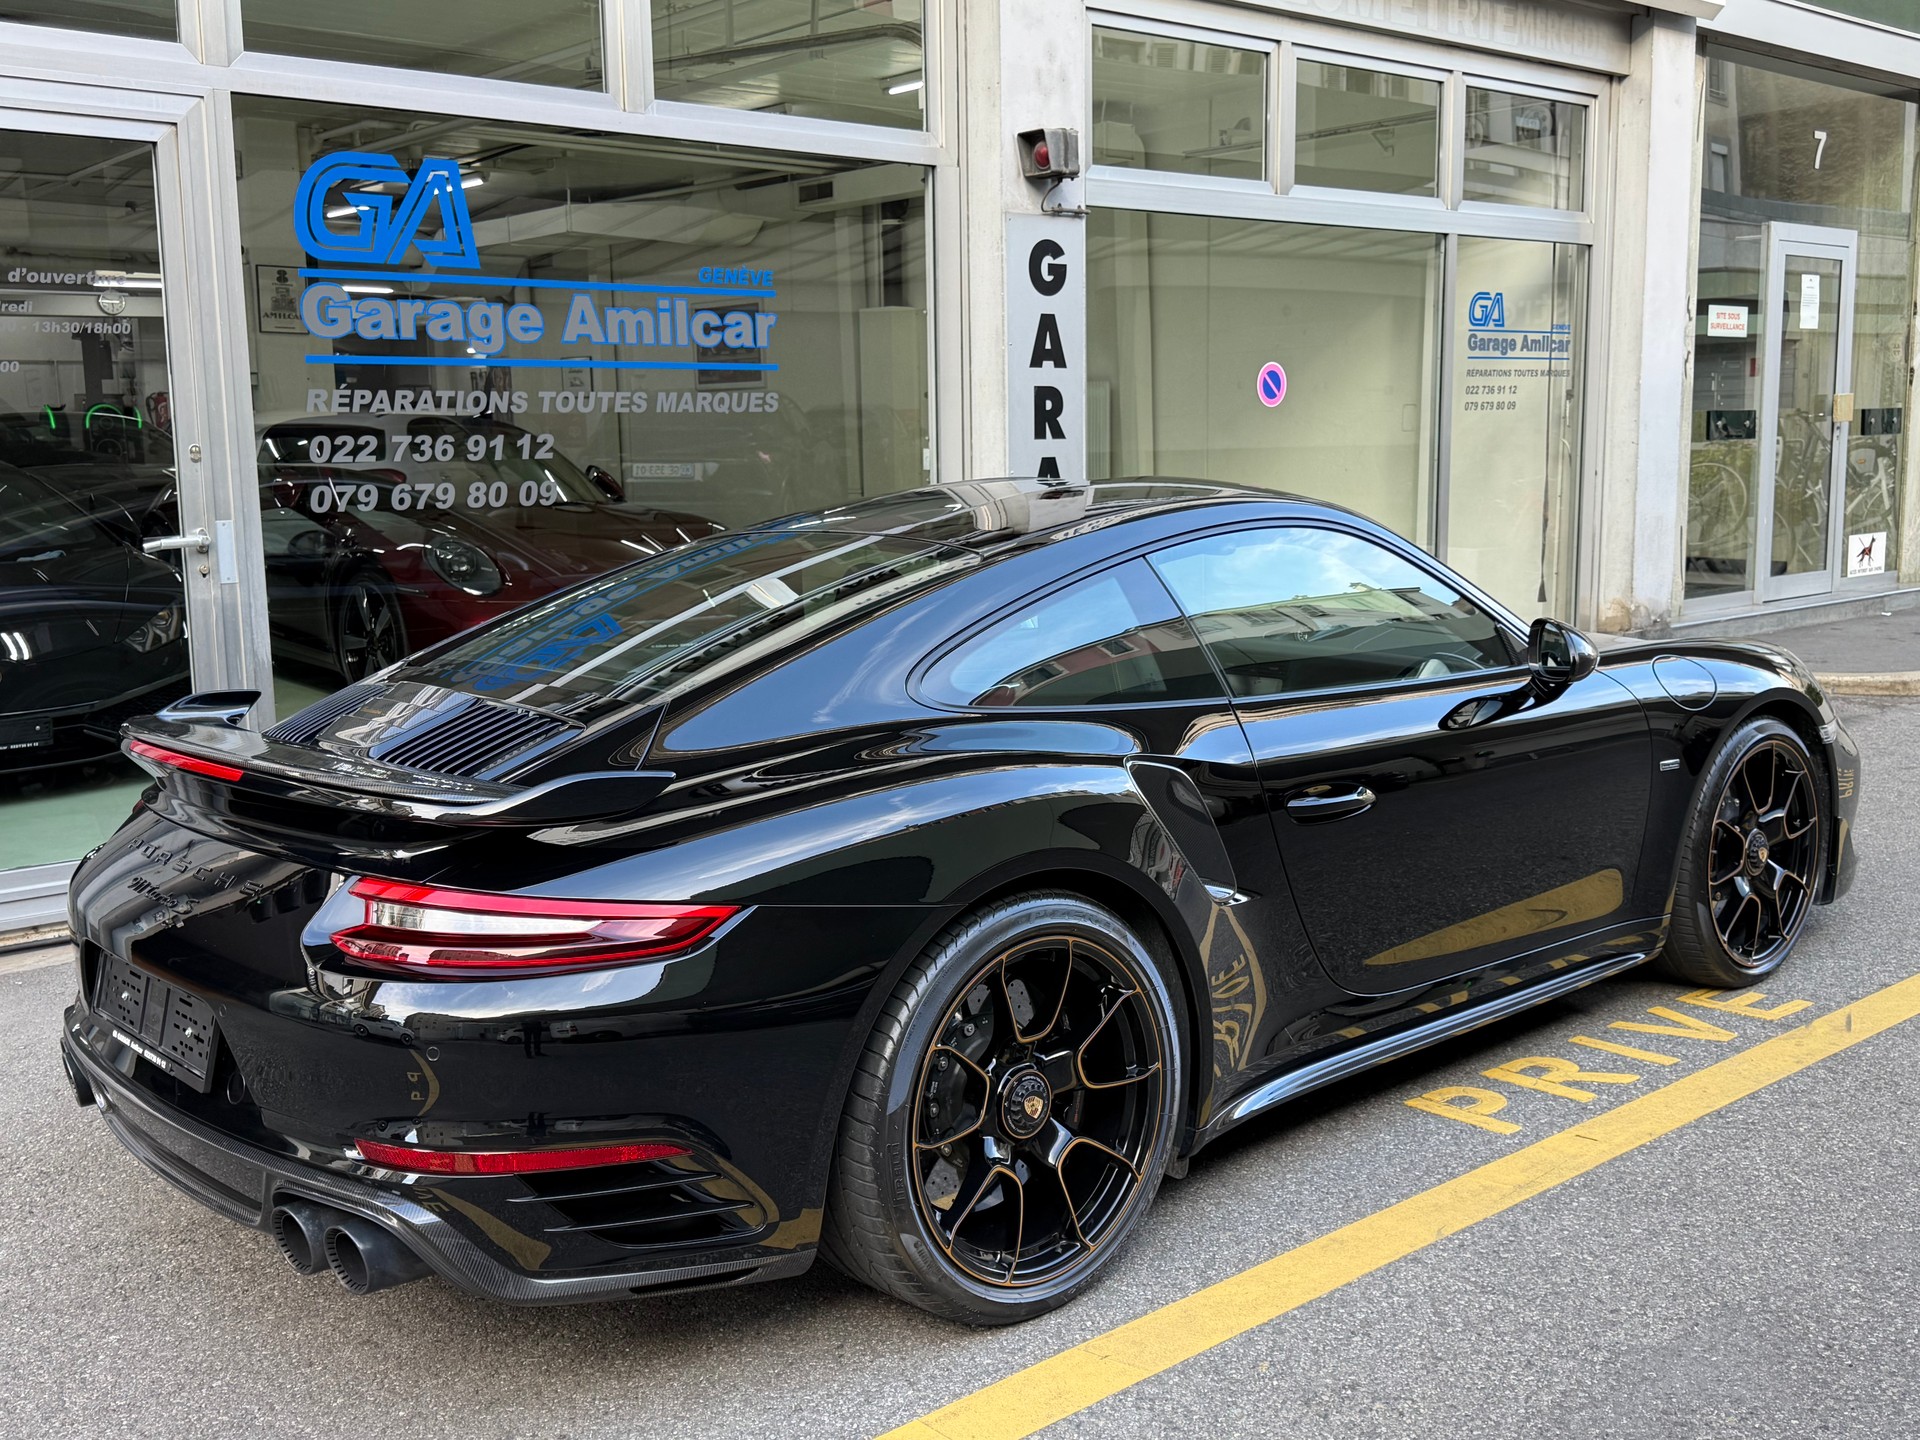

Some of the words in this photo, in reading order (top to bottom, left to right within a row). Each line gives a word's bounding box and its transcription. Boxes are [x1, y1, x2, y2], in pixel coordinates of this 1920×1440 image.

[1814, 130, 1827, 170] 7
[294, 151, 481, 269] GA
[698, 265, 774, 287] GENÈVE
[0, 301, 33, 313] redi
[262, 311, 302, 320] AMILCA
[301, 282, 543, 355] Garage
[561, 293, 779, 349] Amilcar
[1468, 292, 1505, 328] GA
[32, 320, 132, 335] 13h30/18h00
[1710, 322, 1745, 331] SURVEILLANCE
[1468, 333, 1517, 356] Garage
[1520, 335, 1571, 352] Amilcar
[1514, 369, 1539, 378] TOUTES
[1540, 369, 1571, 378] MARQUES
[306, 384, 528, 414] RÉPARATIONS
[538, 391, 648, 414] TOUTES
[656, 392, 779, 415] MARQUES
[1465, 385, 1480, 396] 022
[1481, 385, 1496, 395] 736
[1496, 385, 1506, 395] 91
[1508, 385, 1518, 395] 12
[1464, 401, 1479, 411] 079
[1480, 401, 1495, 411] 679
[1495, 401, 1506, 411] 80
[1506, 401, 1517, 411] 09
[308, 434, 379, 464] 022
[391, 434, 456, 464] 736
[466, 434, 505, 462] 91
[516, 433, 556, 460] 12
[310, 482, 380, 514] 079
[390, 481, 456, 511] 679
[466, 480, 509, 509] 80
[518, 480, 559, 508] 09
[127, 837, 264, 897] PORSCHE
[1404, 988, 1814, 1136] PRIVE
